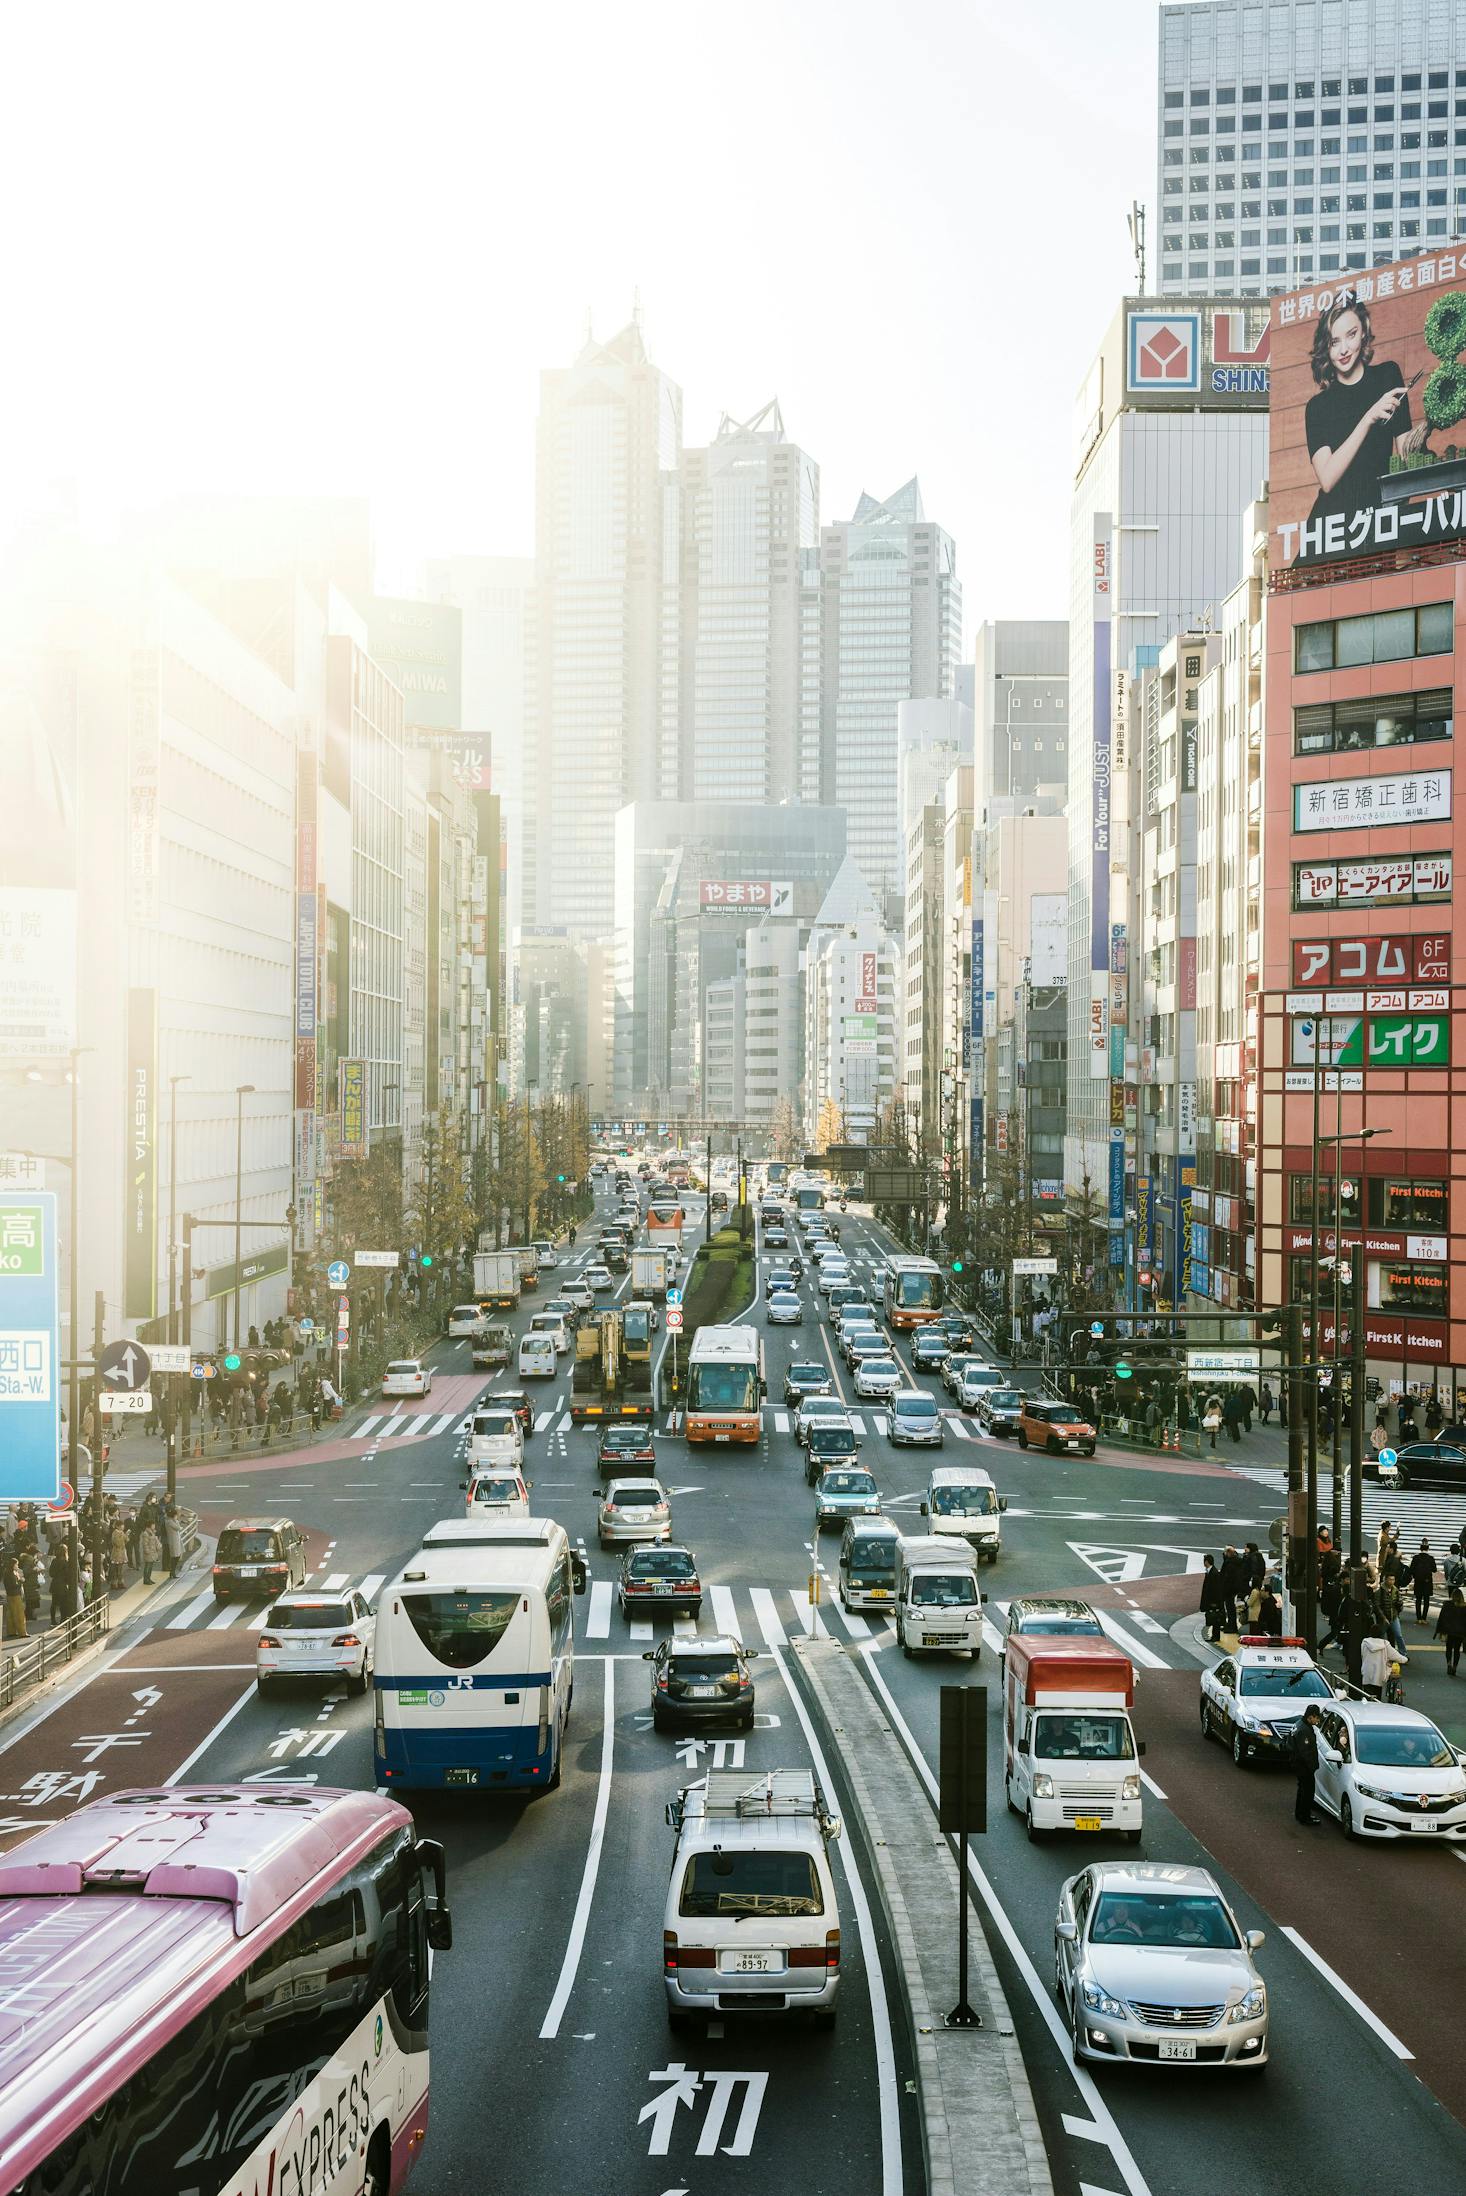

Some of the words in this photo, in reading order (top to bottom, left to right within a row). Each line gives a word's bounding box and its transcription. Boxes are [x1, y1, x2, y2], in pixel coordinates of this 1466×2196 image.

[1094, 543, 1105, 577] LABI
[401, 671, 447, 694] MIWA
[1309, 778, 1442, 813] 新宿矯正歯科
[1094, 829, 1108, 851] For
[705, 883, 766, 903] やまや
[1338, 870, 1450, 896] エーアイアール
[299, 918, 314, 958] JAPAN
[1112, 924, 1126, 936] 6F
[1301, 940, 1406, 981] アコム
[1422, 939, 1445, 958] 6F
[299, 962, 314, 996] TOTAL
[1431, 967, 1448, 978] 入口
[1371, 995, 1402, 1008] アコム
[1413, 994, 1445, 1007] アコム
[299, 998, 314, 1030] CLUB
[1091, 1000, 1102, 1033] LABI
[1369, 1023, 1439, 1056] レイク
[305, 1046, 315, 1107] パソコンスクール
[1286, 1077, 1320, 1086] お部屋探し
[1112, 1086, 1123, 1119] トレカ
[1181, 1167, 1196, 1186] 薬
[2, 1213, 36, 1248] 高
[1366, 1240, 1400, 1251] Kitchen
[1421, 1239, 1432, 1247] 客席
[1367, 1331, 1393, 1344] First
[1393, 1333, 1442, 1348] Kitchen
[0, 1340, 43, 1371] 西口
[1194, 1357, 1253, 1367] 西新宿一丁目
[1256, 1654, 1298, 1663] 警視庁
[447, 1675, 474, 1690] JR
[742, 1959, 769, 1970] 89-97
[1167, 2046, 1195, 2058] 34-61
